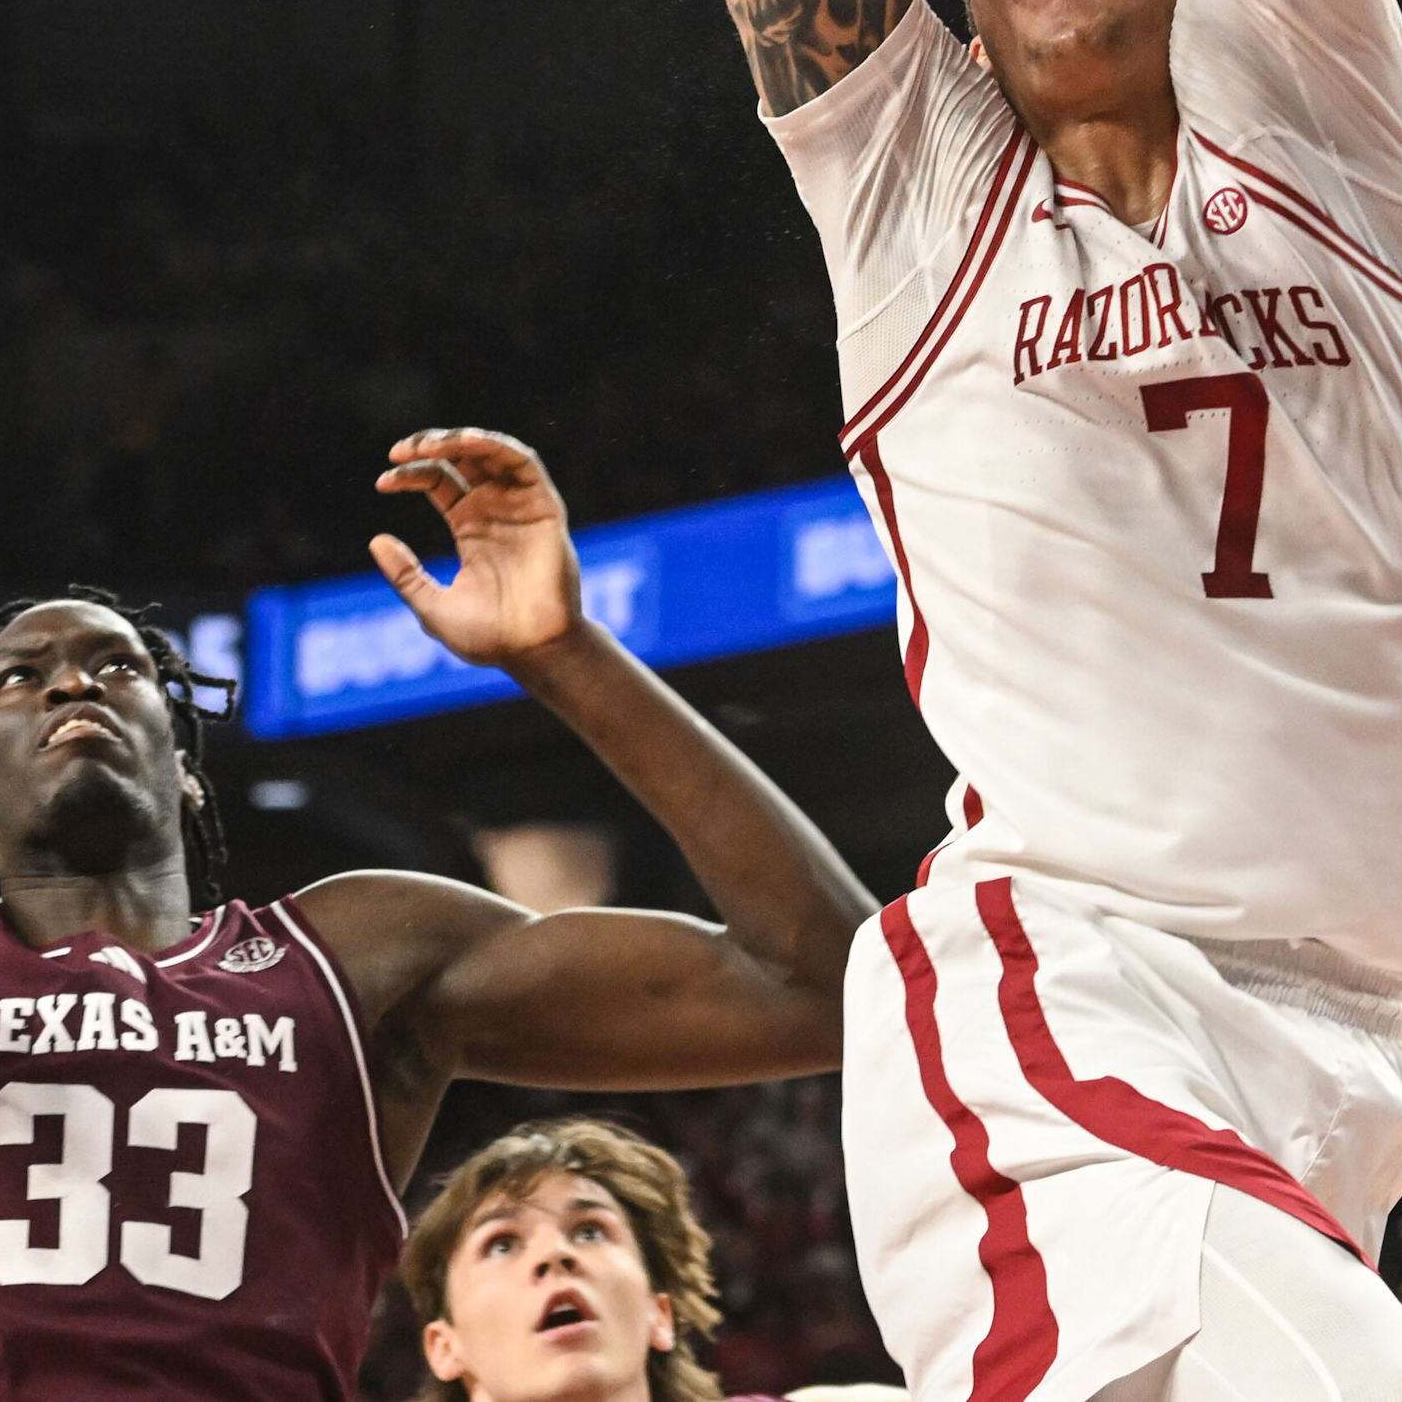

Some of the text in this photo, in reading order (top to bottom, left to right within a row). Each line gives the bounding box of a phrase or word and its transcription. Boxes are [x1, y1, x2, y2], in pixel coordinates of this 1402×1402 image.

[1204, 190, 1245, 232] SEC
[1013, 262, 1352, 386] RAZORCKS
[1139, 372, 1275, 599] 7
[174, 1012, 296, 1072] A&M
